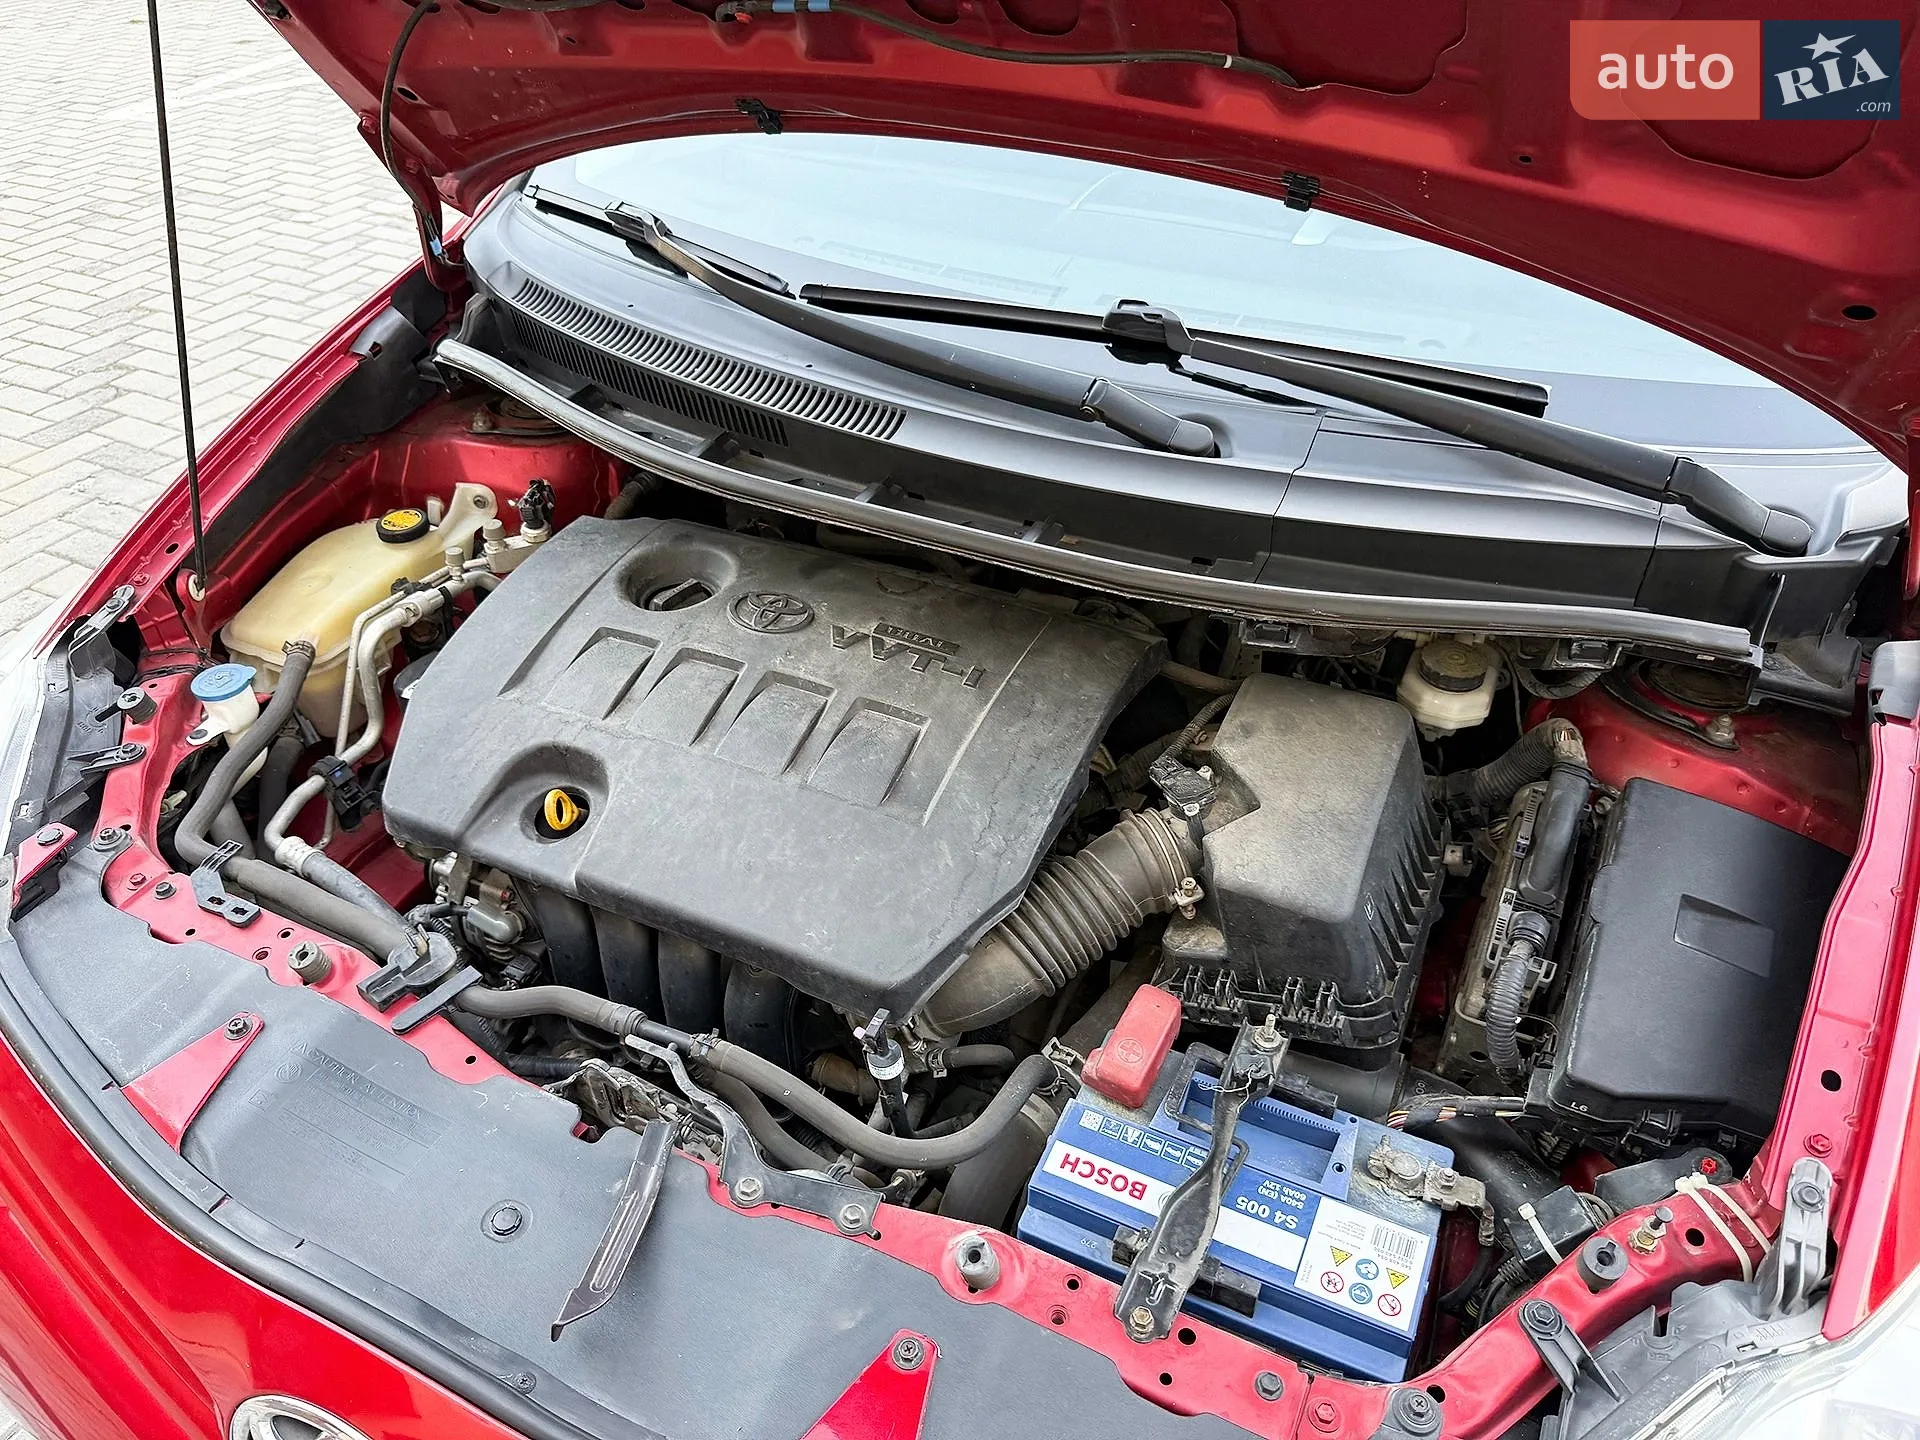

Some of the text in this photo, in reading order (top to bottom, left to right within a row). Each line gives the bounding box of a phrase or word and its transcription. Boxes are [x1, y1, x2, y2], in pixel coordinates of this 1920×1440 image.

[1059, 1153, 1149, 1200] BOSCH
[1236, 1196, 1299, 1229] S4 005
[1257, 1185, 1304, 1209] 540A (EN)
